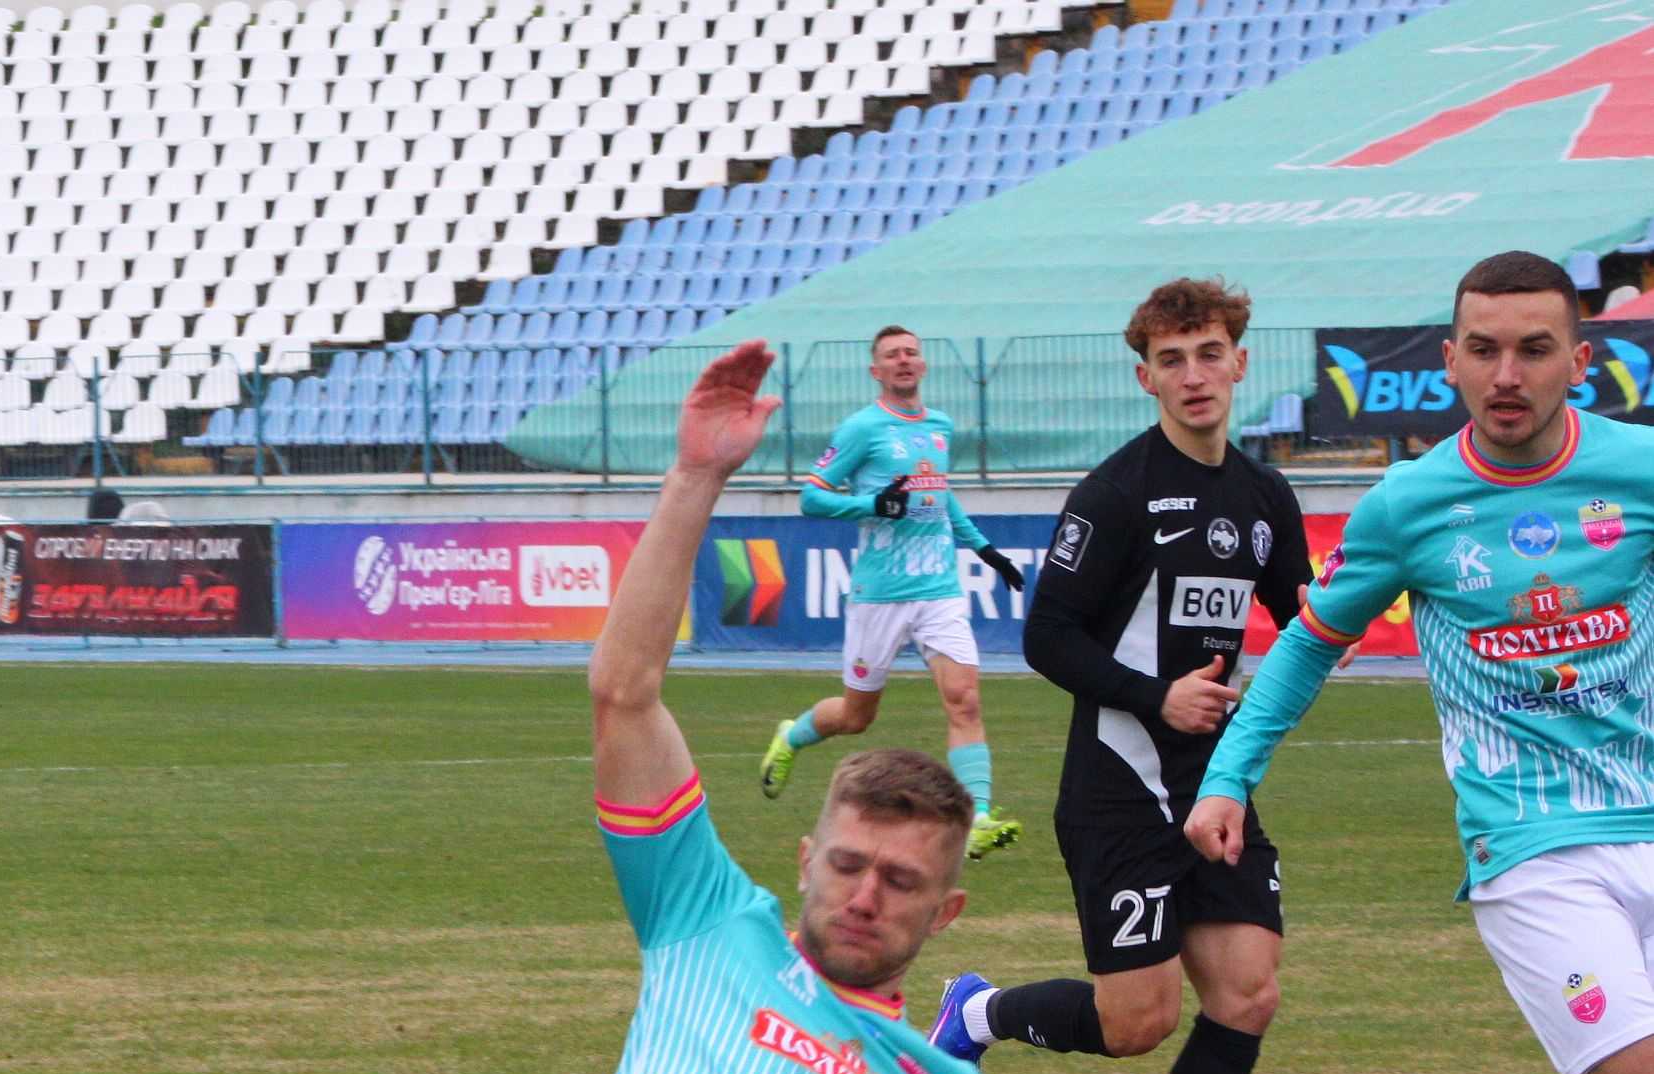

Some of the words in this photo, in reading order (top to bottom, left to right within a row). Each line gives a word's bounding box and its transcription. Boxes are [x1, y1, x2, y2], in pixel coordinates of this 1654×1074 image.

[1363, 369, 1456, 412] BVS
[196, 538, 241, 560] СМАК
[399, 540, 512, 578] Українська
[1182, 587, 1245, 619] BGV
[1479, 609, 1627, 658] ПОЛТАВА
[1110, 885, 1171, 948] 27
